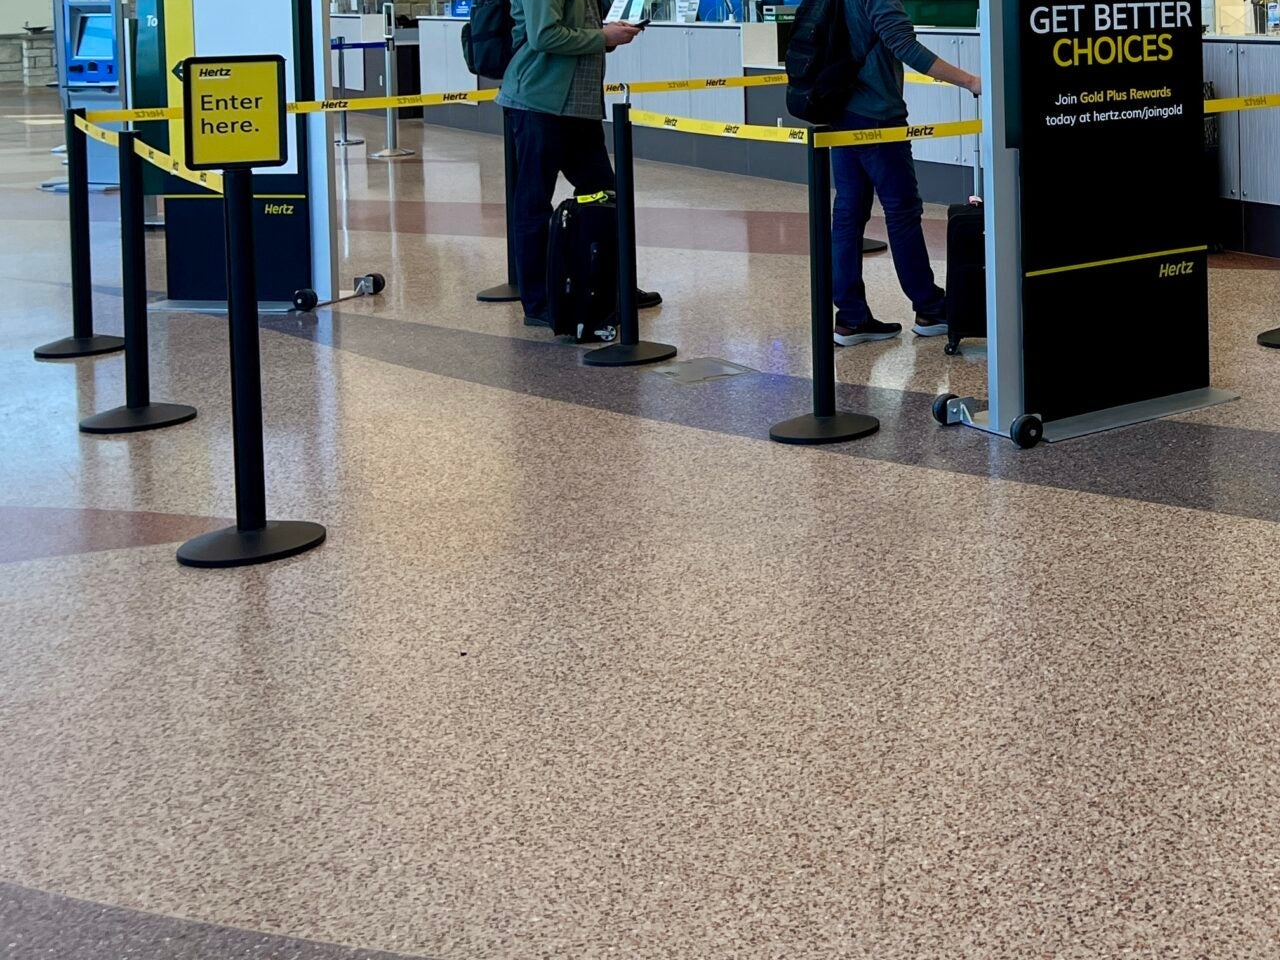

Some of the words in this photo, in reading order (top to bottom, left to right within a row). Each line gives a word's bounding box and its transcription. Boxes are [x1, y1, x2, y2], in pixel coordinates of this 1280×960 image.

[1030, 5, 1085, 34] GET
[1094, 1, 1192, 31] BETTER
[1053, 33, 1173, 67] CHOICES
[199, 68, 231, 77] Hertz
[606, 83, 624, 92] Her
[706, 79, 727, 87] Hertz
[443, 92, 468, 101] Hertz
[1055, 94, 1077, 105] Join
[1080, 91, 1104, 103] Gold
[1106, 89, 1127, 101] Plus
[1130, 86, 1172, 100] Rewards
[201, 95, 263, 111] Enter
[321, 100, 349, 109] Hertz
[664, 116, 678, 127] Hertz
[1046, 114, 1077, 127] today
[1079, 112, 1091, 124] at
[1093, 104, 1183, 122] hertz.com/joingold
[201, 118, 259, 134] here.
[725, 124, 740, 134] Hertz
[906, 125, 934, 138] Hertz
[788, 129, 805, 139] Hertz
[264, 203, 295, 215] Hertz
[1159, 260, 1194, 277] Hertz
